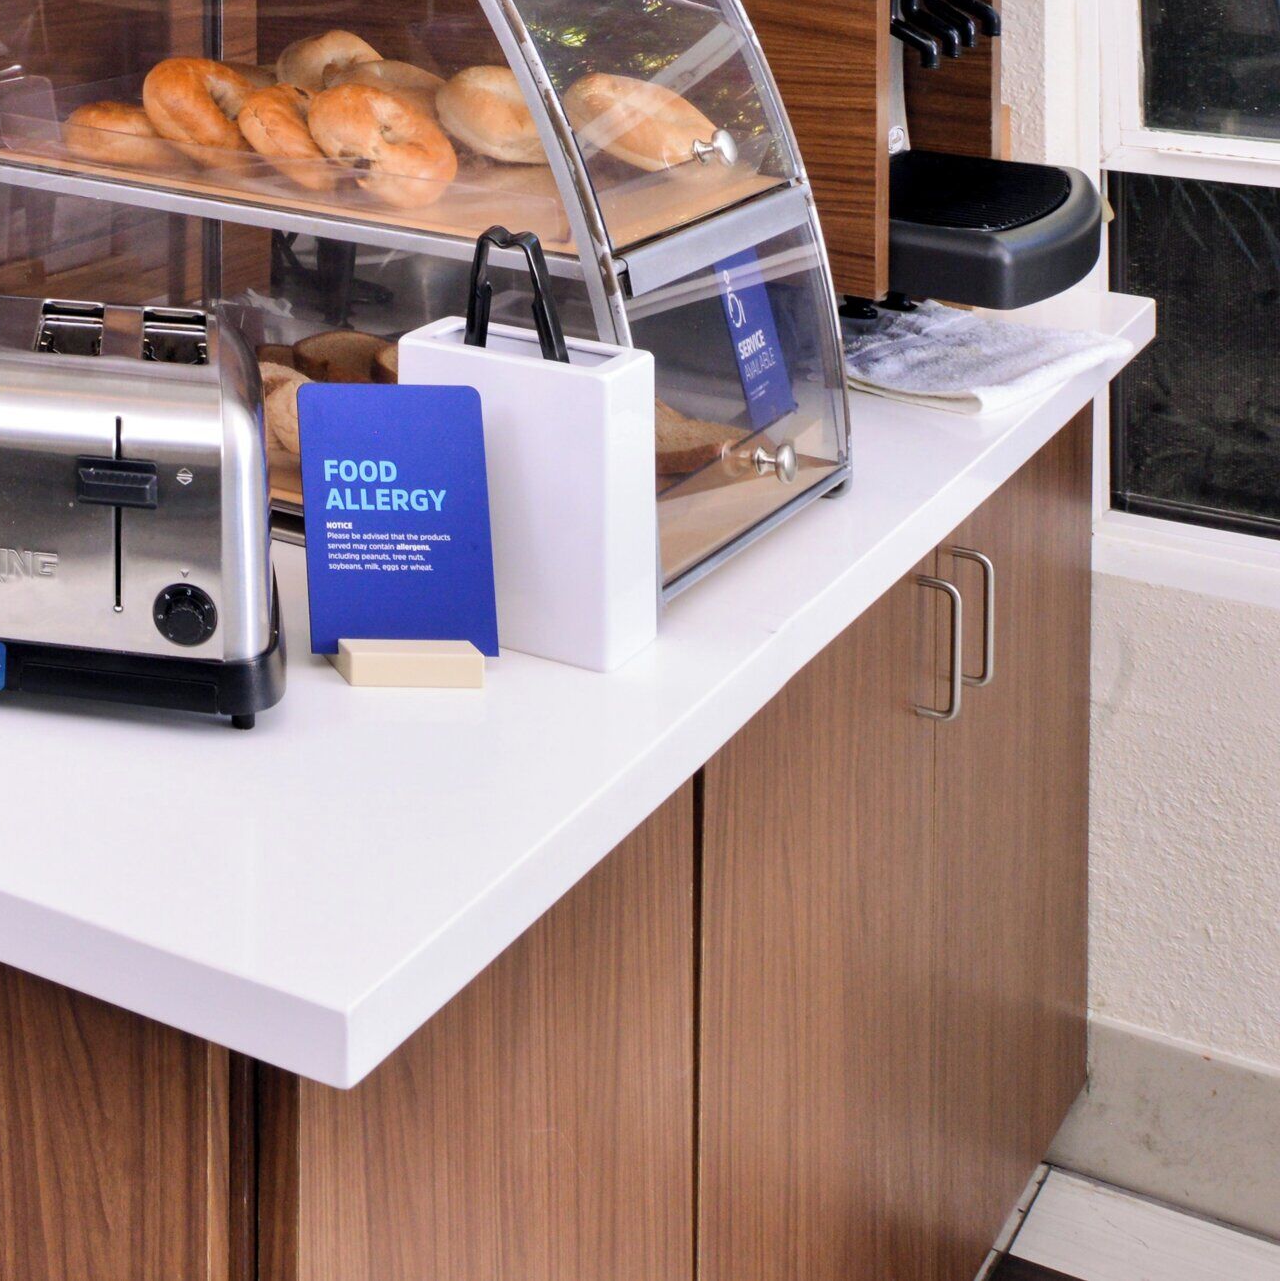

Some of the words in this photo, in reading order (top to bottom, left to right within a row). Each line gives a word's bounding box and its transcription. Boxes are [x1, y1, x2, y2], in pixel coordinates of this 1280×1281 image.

[738, 329, 766, 359] SERVICE
[324, 460, 397, 482] FOOD
[325, 488, 446, 511] ALLERGY
[327, 532, 350, 540] Please
[351, 532, 361, 540] be
[362, 532, 389, 540] advised
